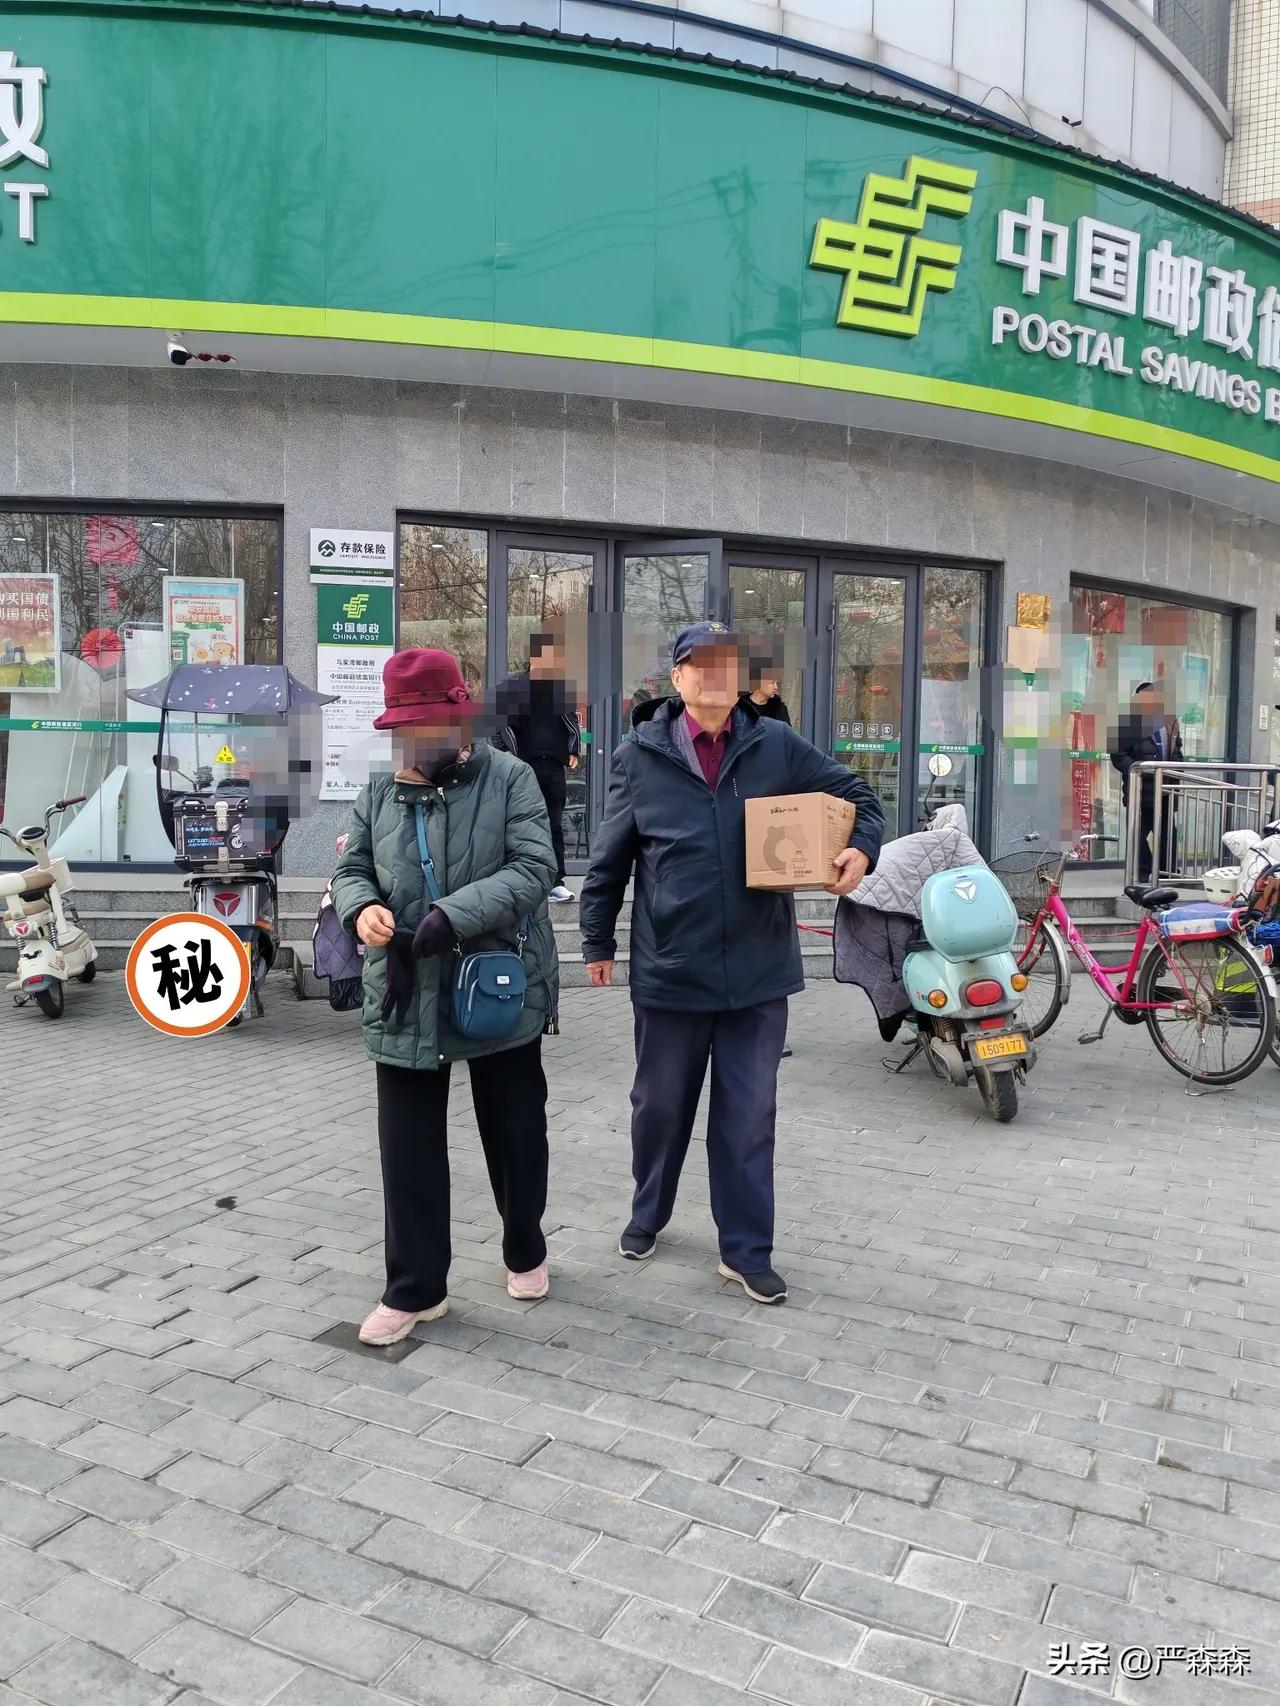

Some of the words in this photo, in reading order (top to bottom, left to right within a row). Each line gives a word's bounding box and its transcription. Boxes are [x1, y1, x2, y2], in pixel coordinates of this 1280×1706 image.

[992, 305, 1133, 376] POSTAL
[1140, 345, 1261, 415] SAVINGS
[340, 542, 386, 555] 存款保险
[332, 621, 380, 633] 中国邮政
